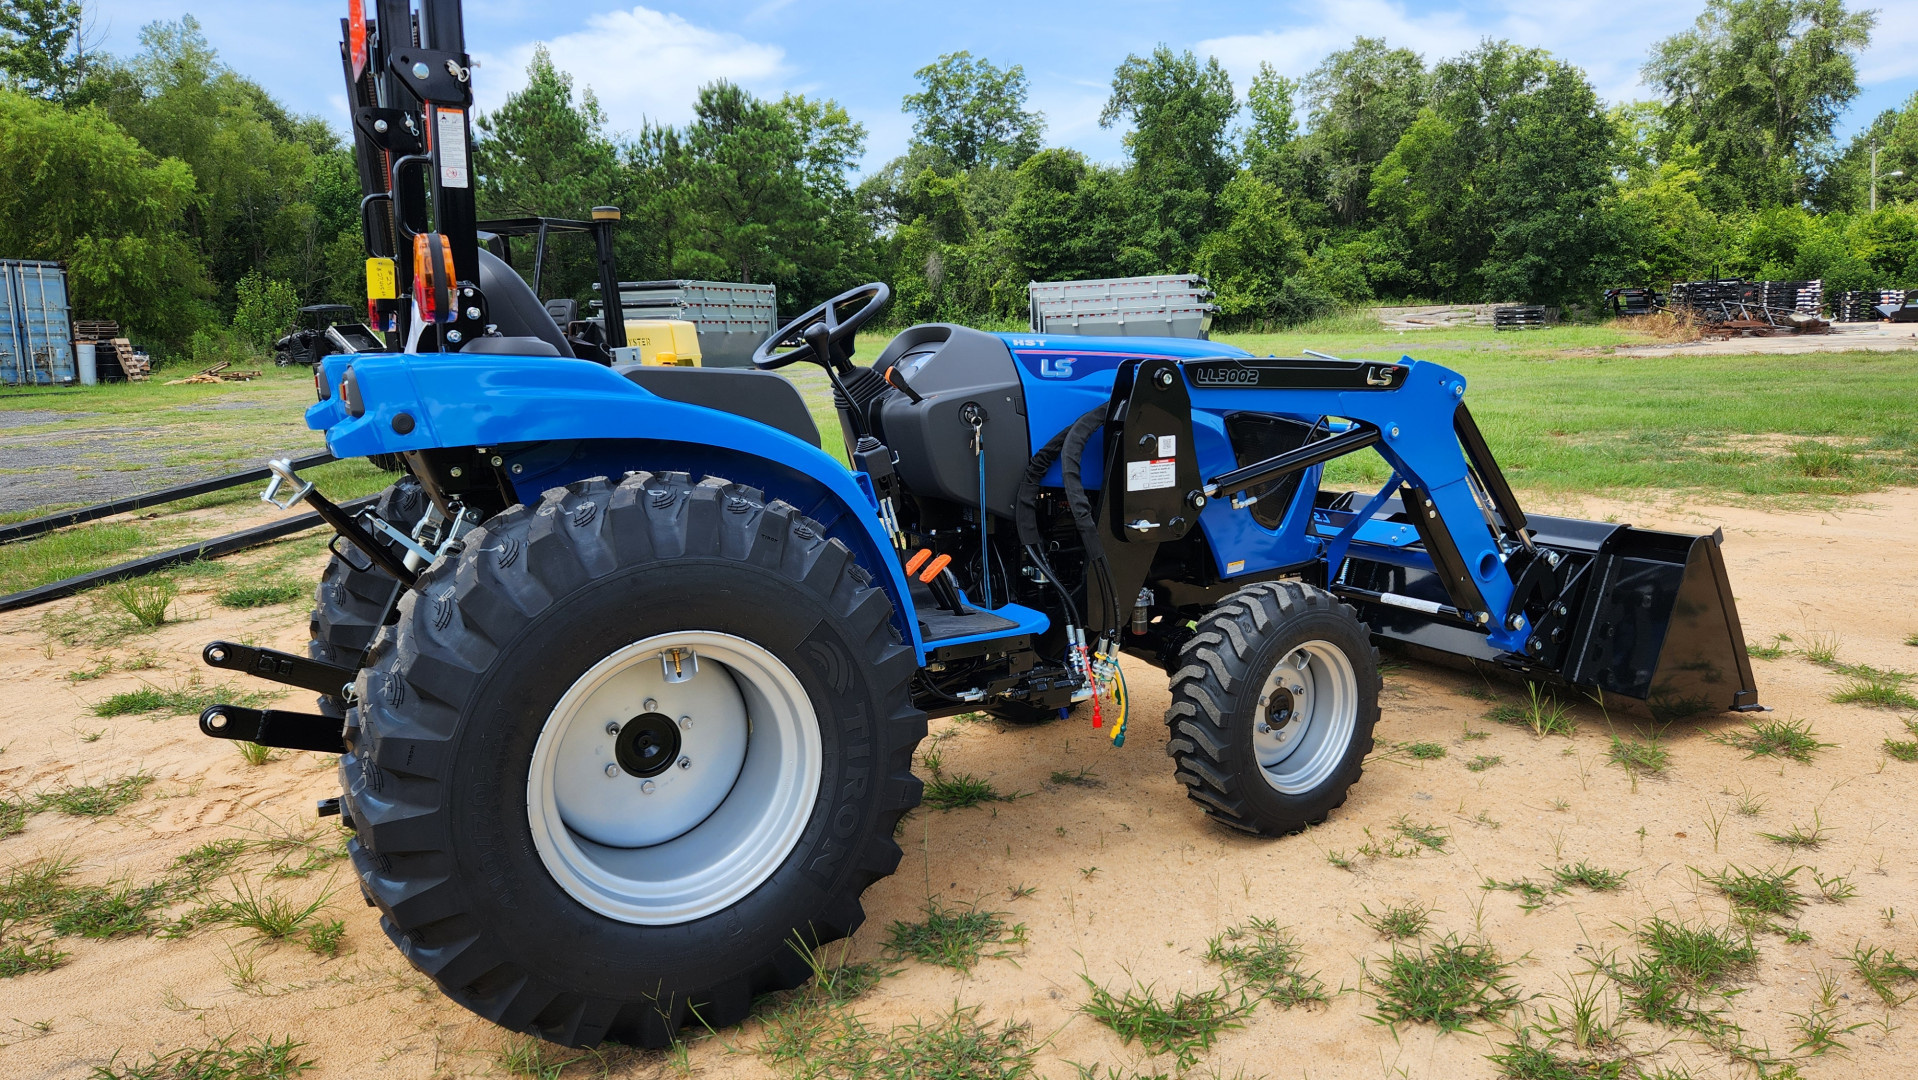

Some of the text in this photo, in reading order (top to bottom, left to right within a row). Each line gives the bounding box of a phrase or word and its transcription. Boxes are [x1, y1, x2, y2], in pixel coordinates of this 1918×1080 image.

[628, 337, 651, 346] YSTER
[1012, 339, 1047, 347] HST
[1041, 357, 1077, 378] LS
[1366, 366, 1399, 386] LS
[1197, 369, 1259, 385] LL3002
[809, 702, 871, 880] TIRON
